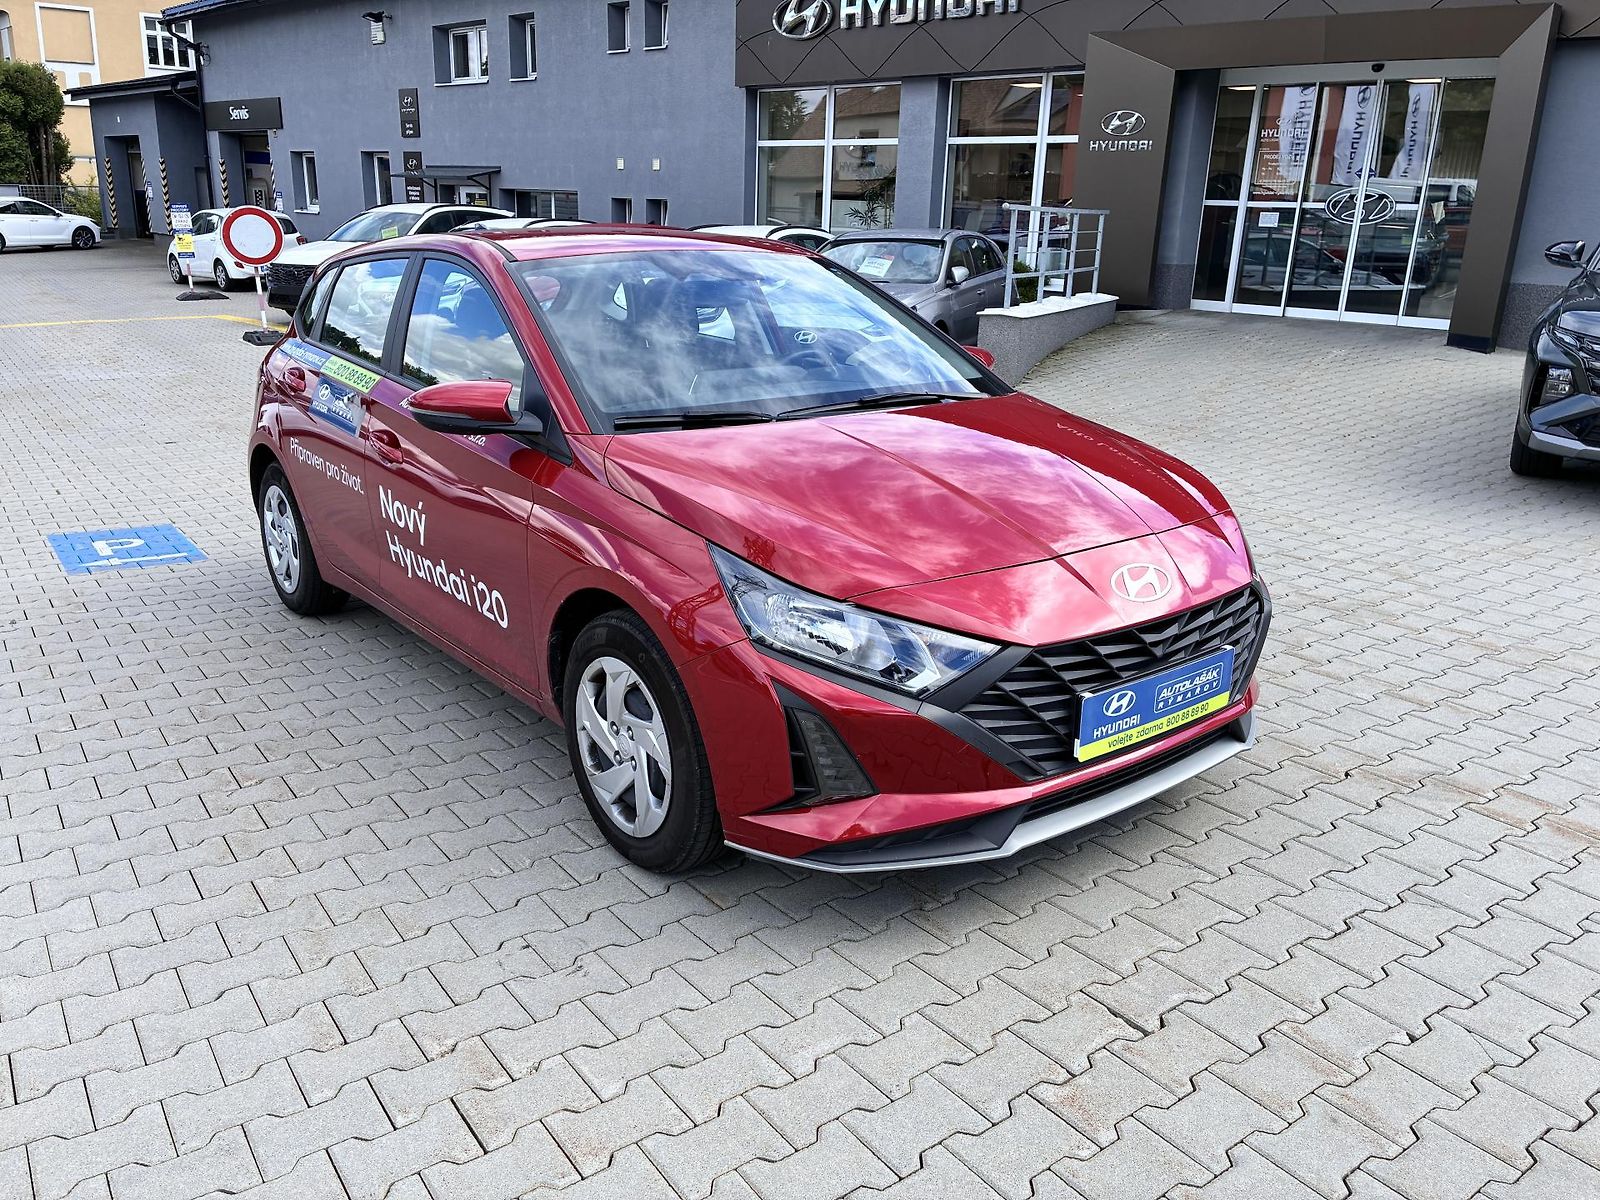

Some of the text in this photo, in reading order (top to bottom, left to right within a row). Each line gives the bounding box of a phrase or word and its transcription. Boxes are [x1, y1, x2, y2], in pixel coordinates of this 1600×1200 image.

[229, 105, 250, 120] Servis
[1089, 140, 1153, 152] HYUNDAI
[1261, 128, 1305, 138] HYUNDAI
[334, 363, 349, 378] 800
[345, 369, 359, 382] 88
[353, 372, 366, 386] 89
[361, 375, 376, 390] 90
[290, 437, 364, 495] Připraven pro život.
[378, 484, 426, 546] Nový
[386, 530, 509, 629] Hyundai i20
[1093, 714, 1141, 739] HYUNDAI
[1108, 702, 1209, 748] volejte zdarma 800 88 89 90
